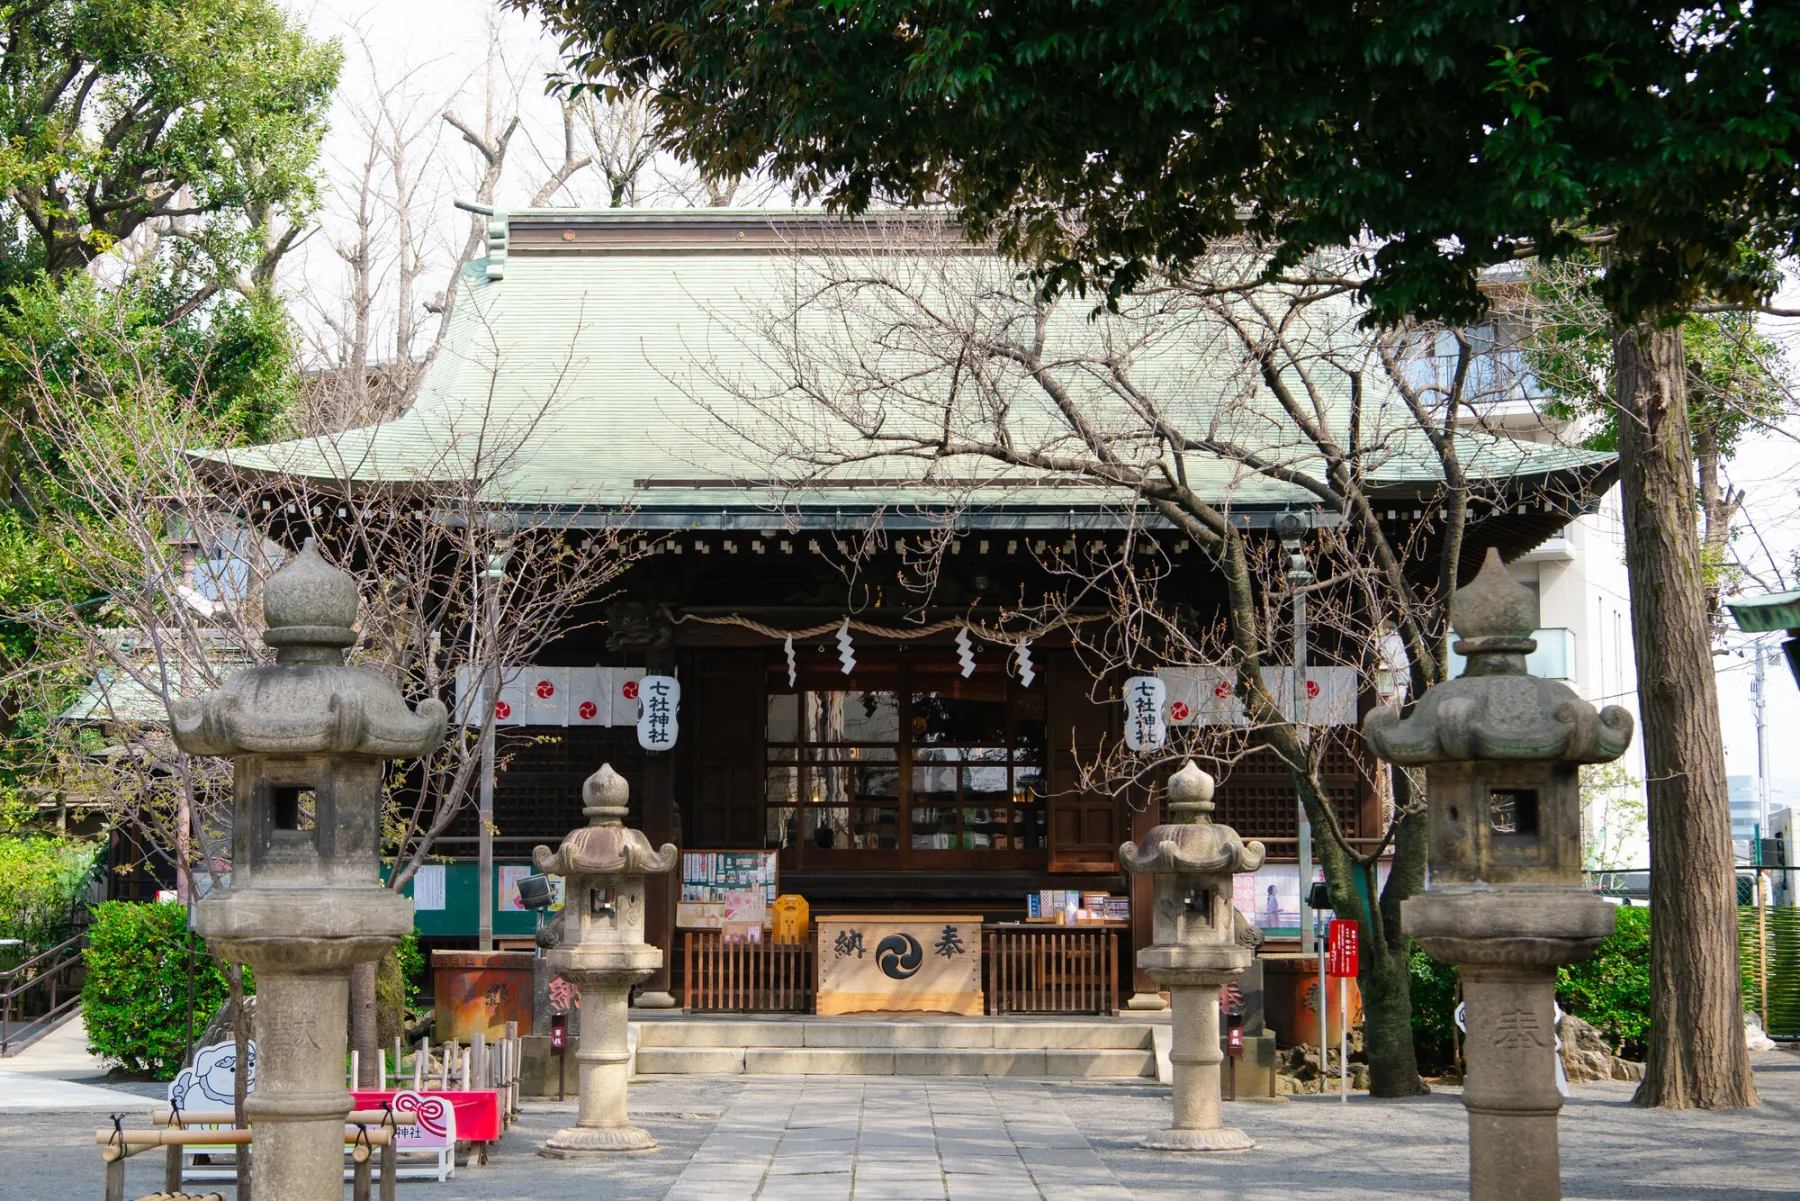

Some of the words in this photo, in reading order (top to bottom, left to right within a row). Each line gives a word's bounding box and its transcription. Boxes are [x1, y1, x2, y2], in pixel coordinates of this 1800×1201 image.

[648, 680, 671, 744] 七社神社
[1134, 681, 1157, 745] 七社神社
[833, 928, 868, 959] 納
[934, 924, 966, 960] 奉
[1494, 1008, 1547, 1052] 奉
